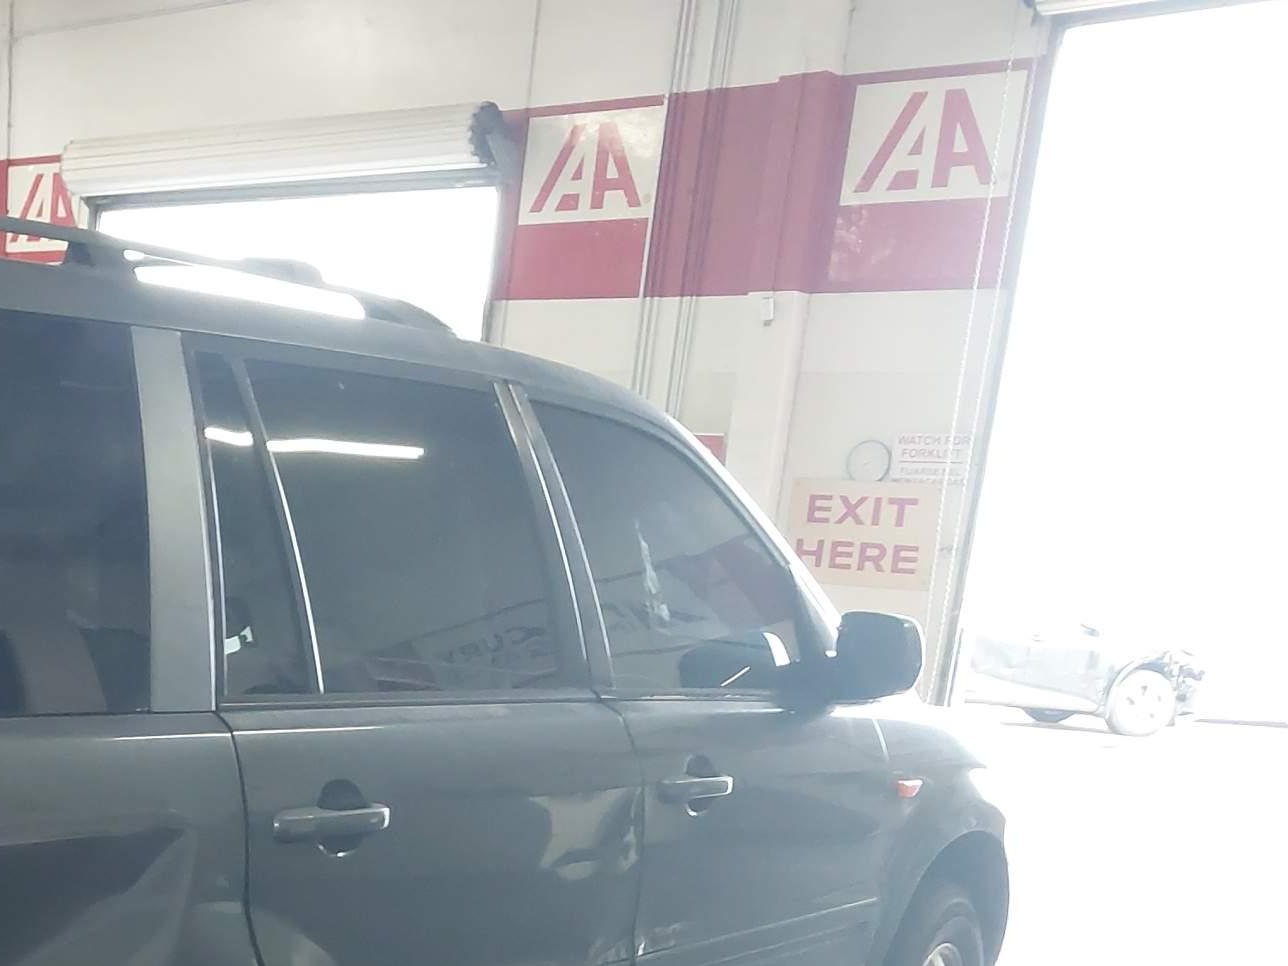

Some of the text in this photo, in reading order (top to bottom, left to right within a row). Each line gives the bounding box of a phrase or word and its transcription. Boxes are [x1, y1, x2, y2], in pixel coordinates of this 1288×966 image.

[897, 434, 941, 446] WATCH
[806, 493, 920, 528] EXIT
[795, 537, 920, 575] HERE
